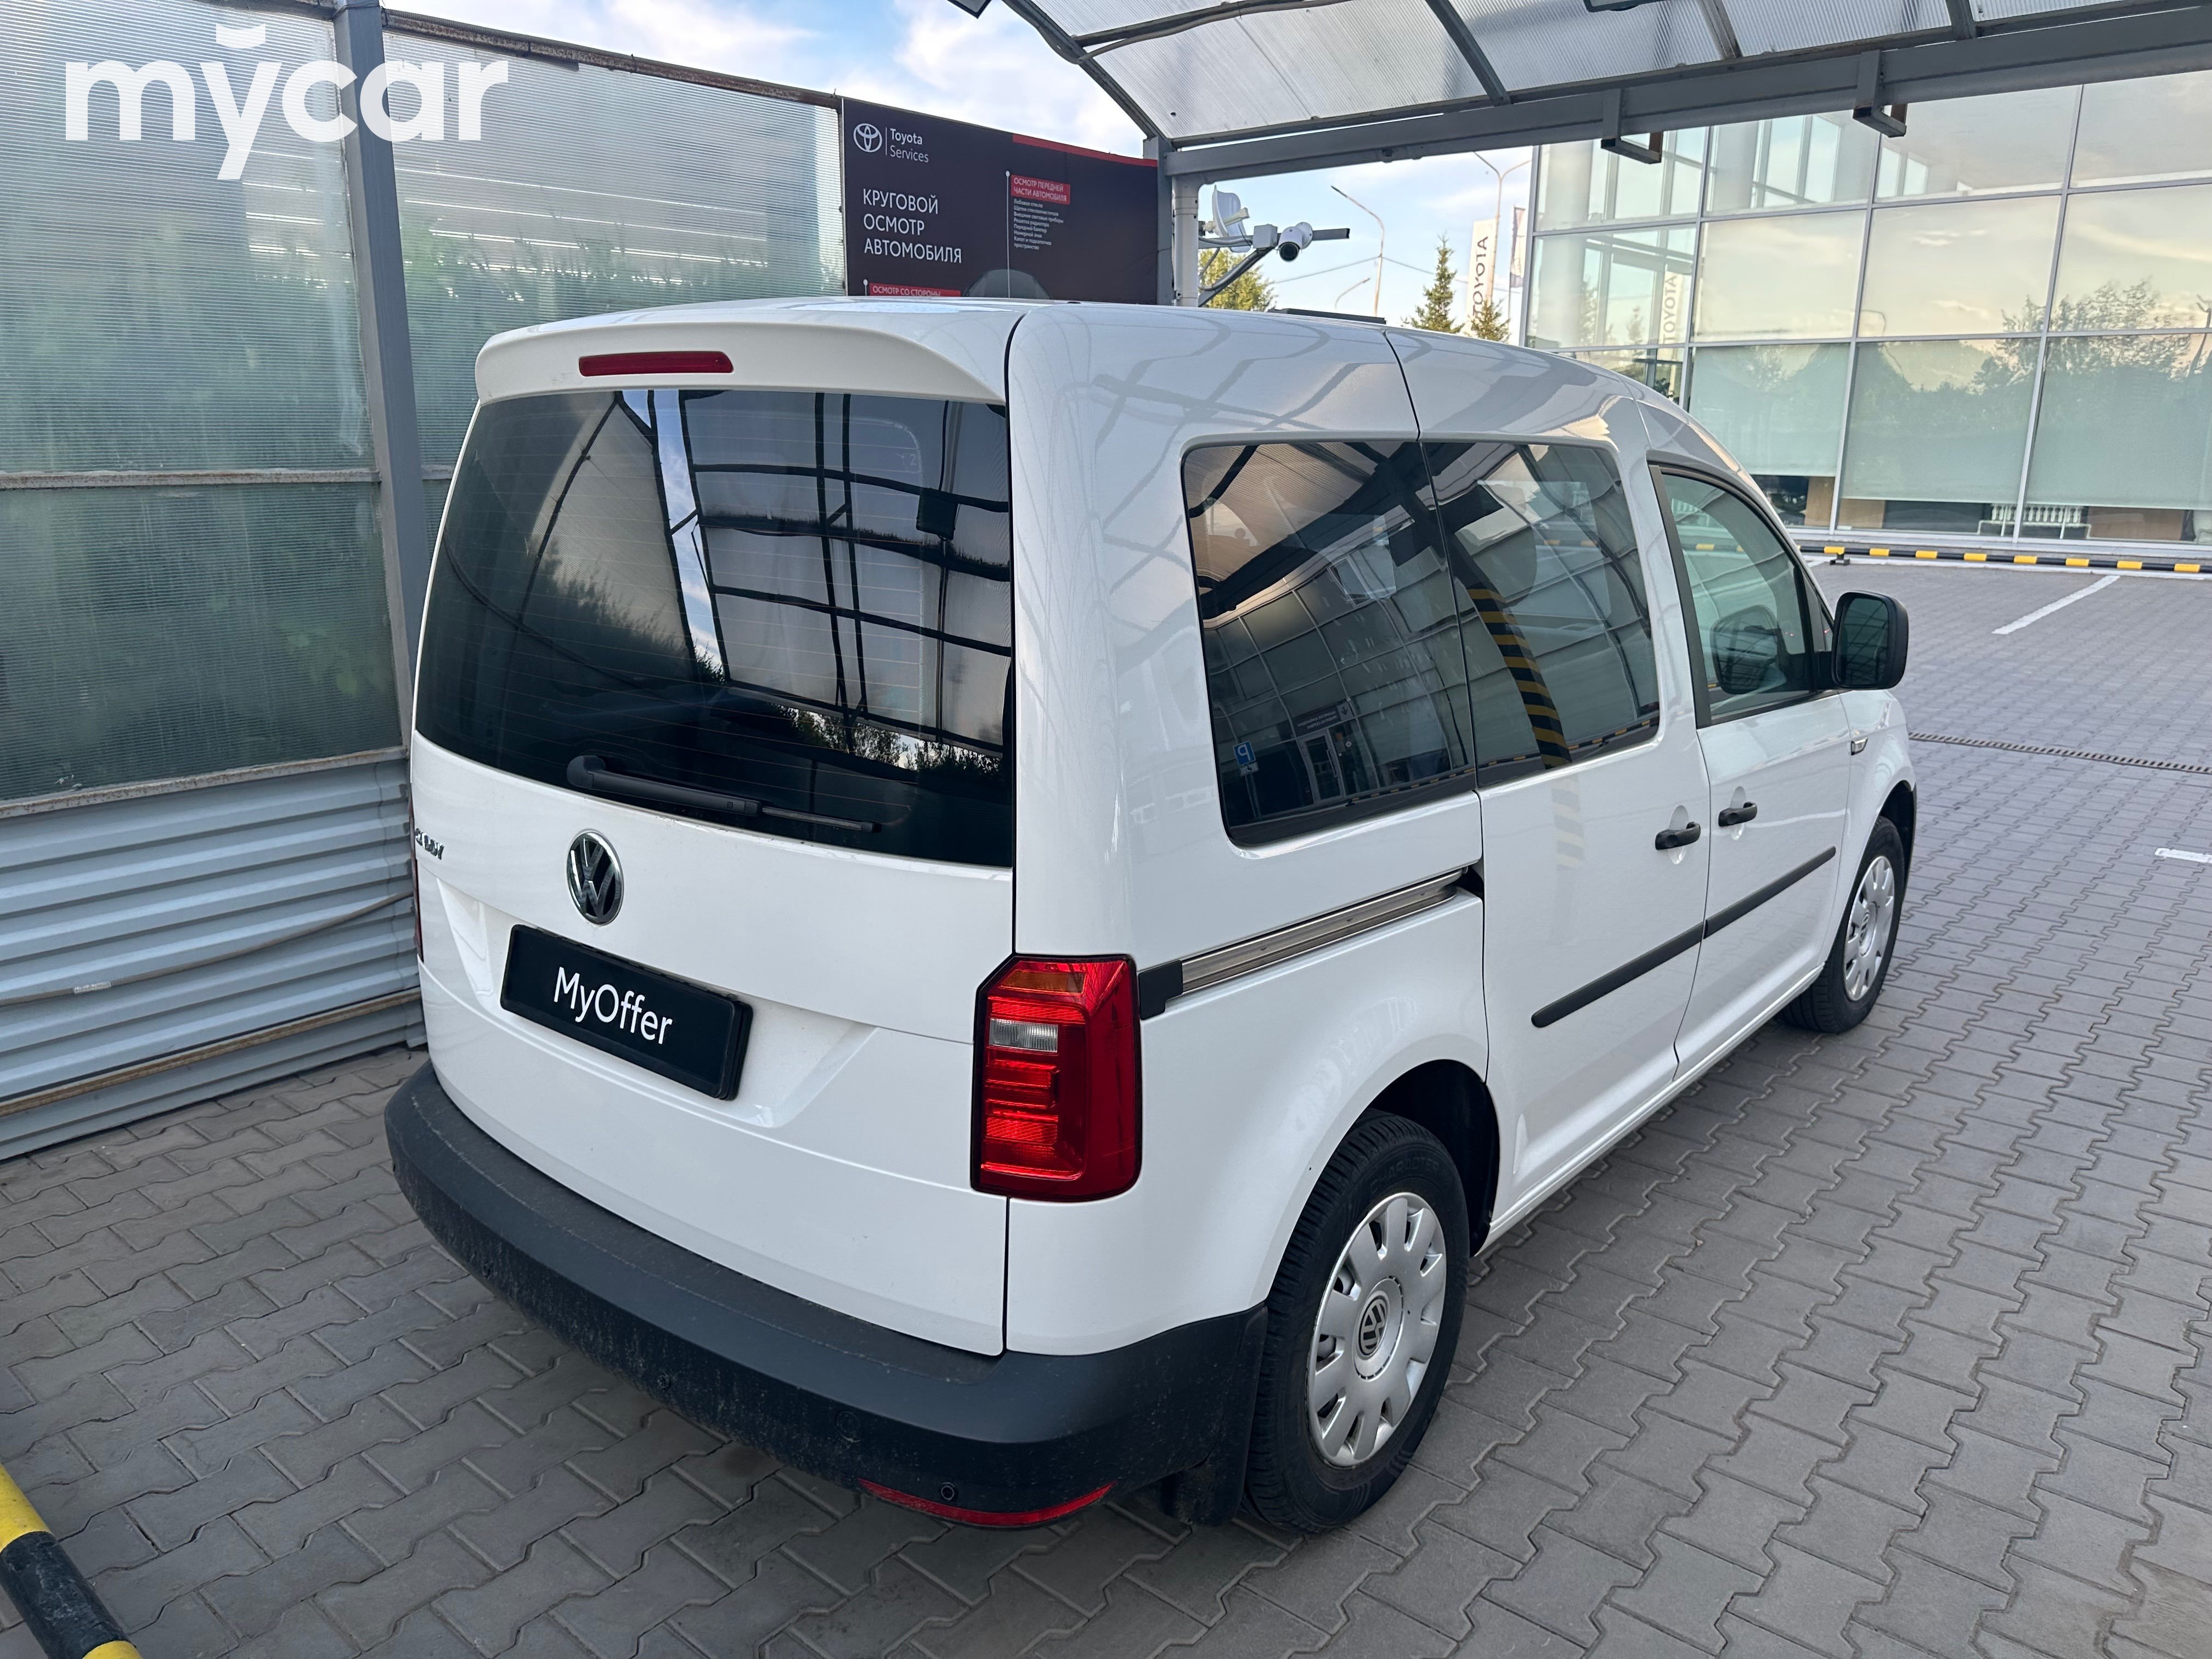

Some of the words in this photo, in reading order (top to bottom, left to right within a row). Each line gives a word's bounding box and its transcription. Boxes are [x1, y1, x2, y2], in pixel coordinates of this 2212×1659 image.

[890, 127, 923, 145] Toyota
[889, 145, 929, 163] Services
[1013, 177, 1037, 188] ОСМОТР
[1037, 181, 1064, 192] ПЕРЕДНЕЙ
[1013, 187, 1032, 196] ЧАСТИ
[1032, 189, 1068, 202] АВТОМОБИЛЯ
[863, 188, 939, 215] КРУГОВОЙ
[863, 213, 926, 235] ОСМОТР
[864, 238, 962, 263] АВТОМОБИЛЯ
[1472, 236, 1488, 317] TOYOTA
[872, 285, 899, 295] ОСМОТР
[1663, 275, 1677, 344] TOYOTA
